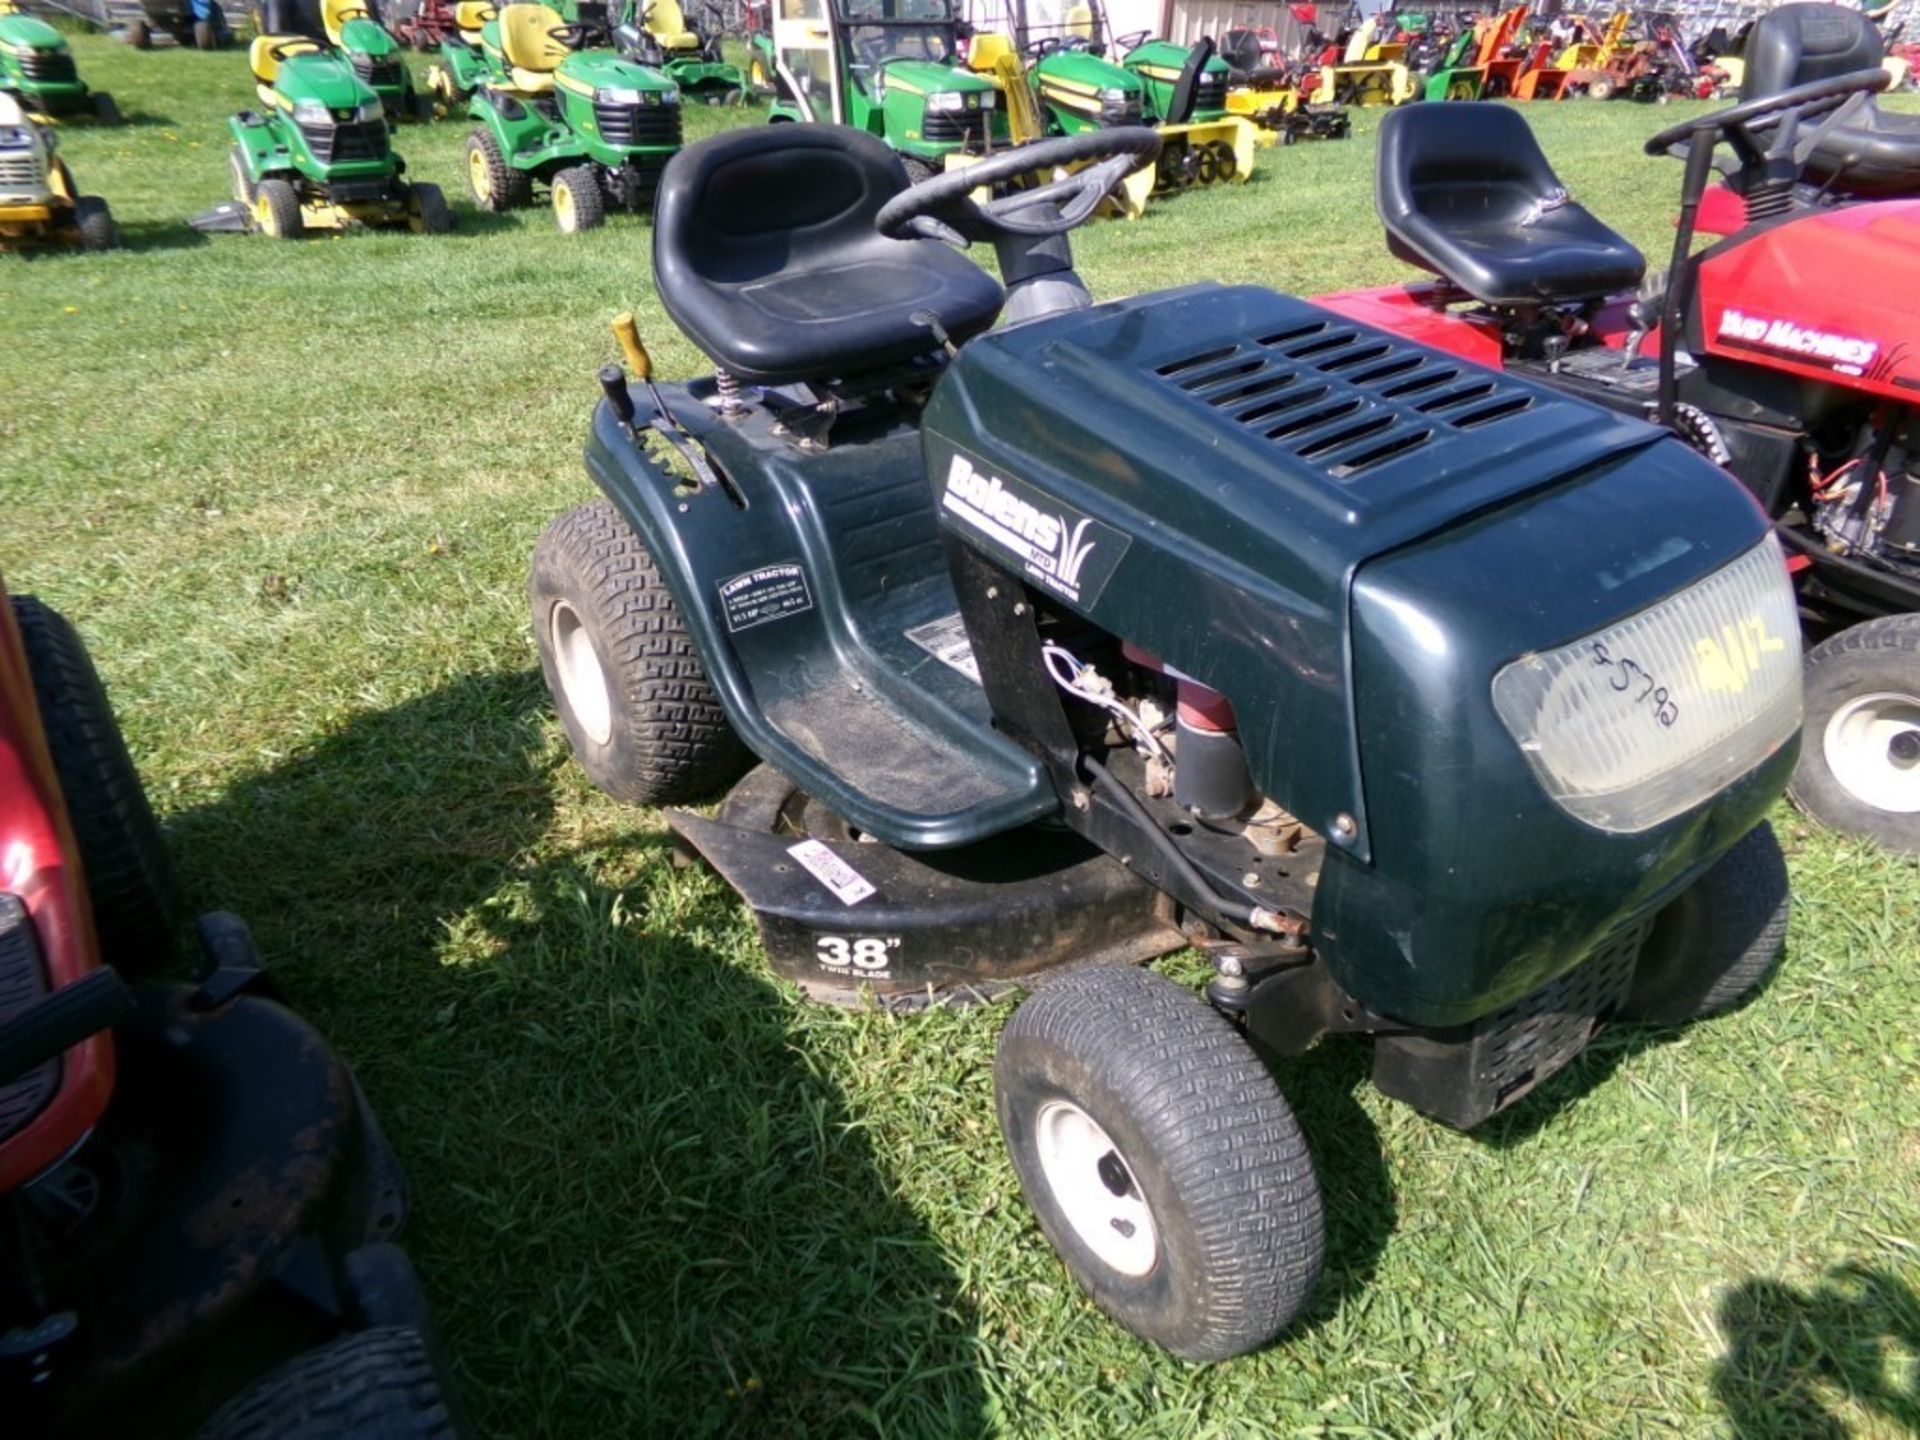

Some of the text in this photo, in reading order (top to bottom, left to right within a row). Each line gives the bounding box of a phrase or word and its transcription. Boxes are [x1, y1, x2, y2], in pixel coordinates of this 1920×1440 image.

[947, 454, 1060, 552] Bolens
[724, 578, 752, 595] LAWN
[753, 568, 798, 582] TRACTOR
[852, 968, 891, 979] BLADE
